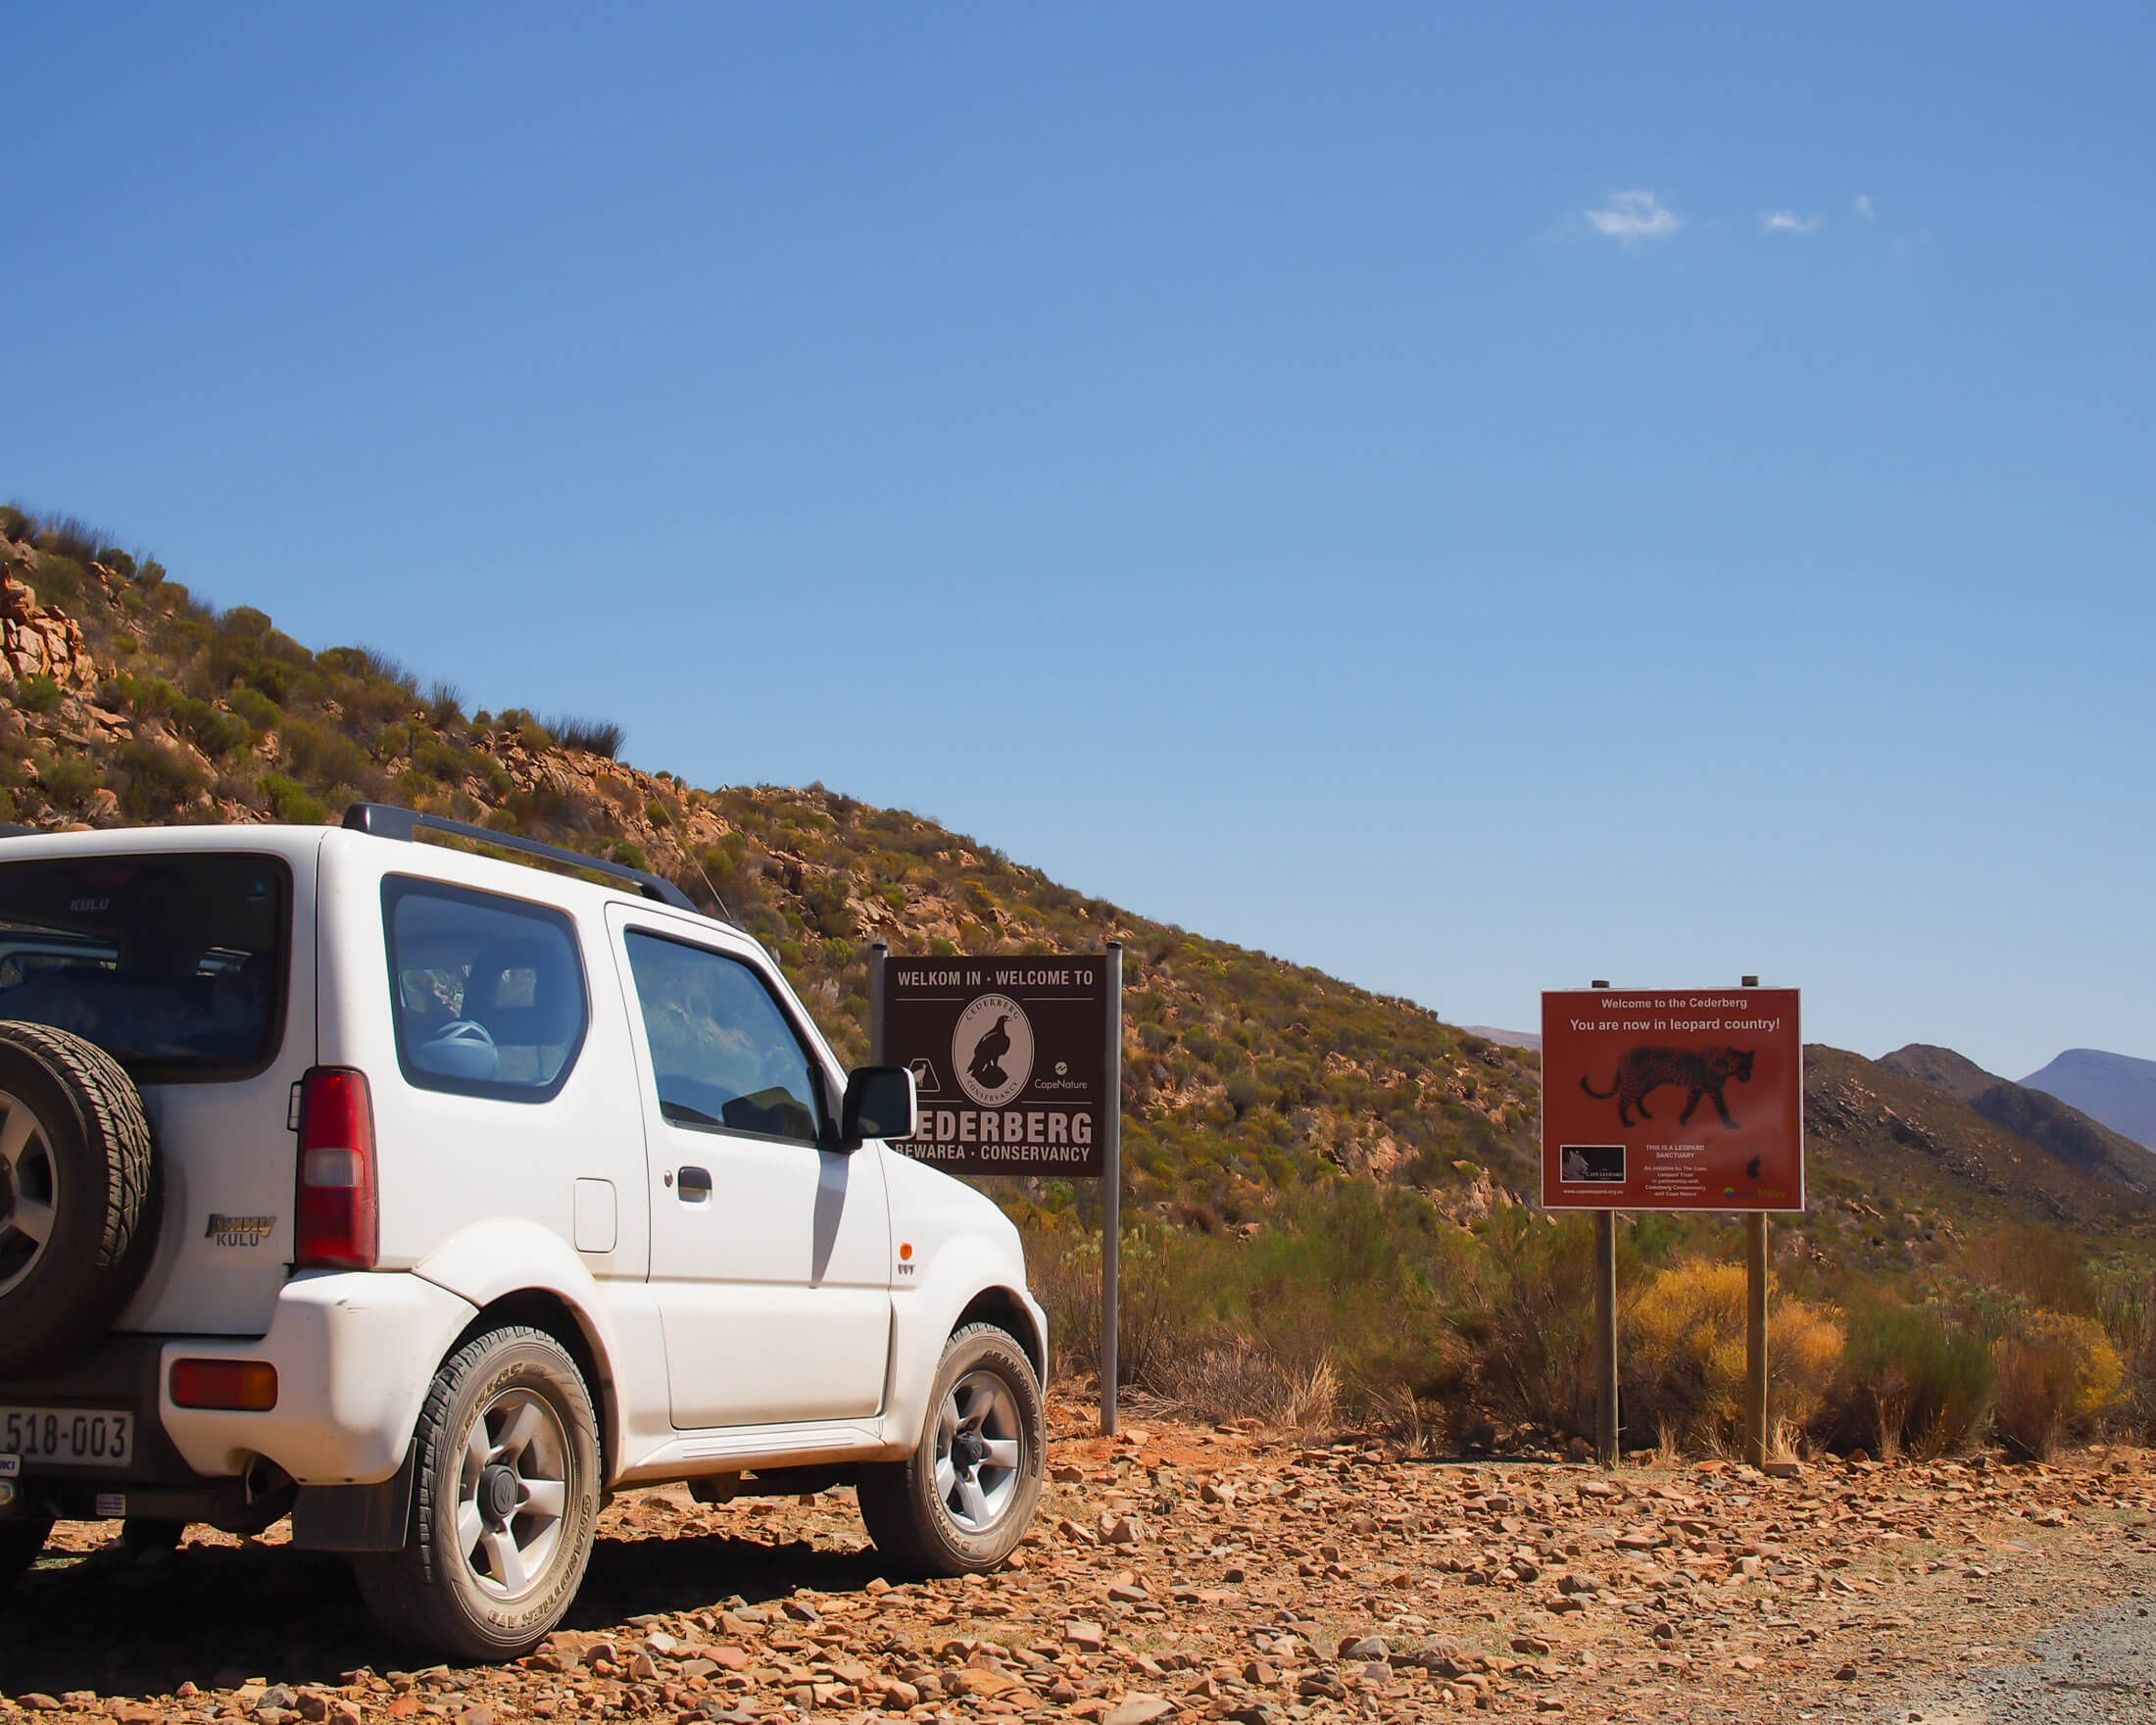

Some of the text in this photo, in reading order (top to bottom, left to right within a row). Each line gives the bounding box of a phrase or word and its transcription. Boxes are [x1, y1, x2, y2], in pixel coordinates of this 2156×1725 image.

[71, 897, 110, 911] KULU
[898, 970, 1094, 986] WELKOM IN WELCOME TO
[965, 998, 1020, 1020] CEDERBERG
[1601, 997, 1747, 1010] Welcome to the Cederberg
[1570, 1017, 1780, 1032] You are now in leopard country!
[966, 1079, 1018, 1102] CONSERVANCY
[1034, 1078, 1088, 1091] CapeNature
[915, 1110, 1093, 1144] EDERBERG
[981, 1145, 1090, 1162] CONSERVANCY
[217, 1233, 259, 1247] KULU
[7, 1412, 126, 1458] 518-003
